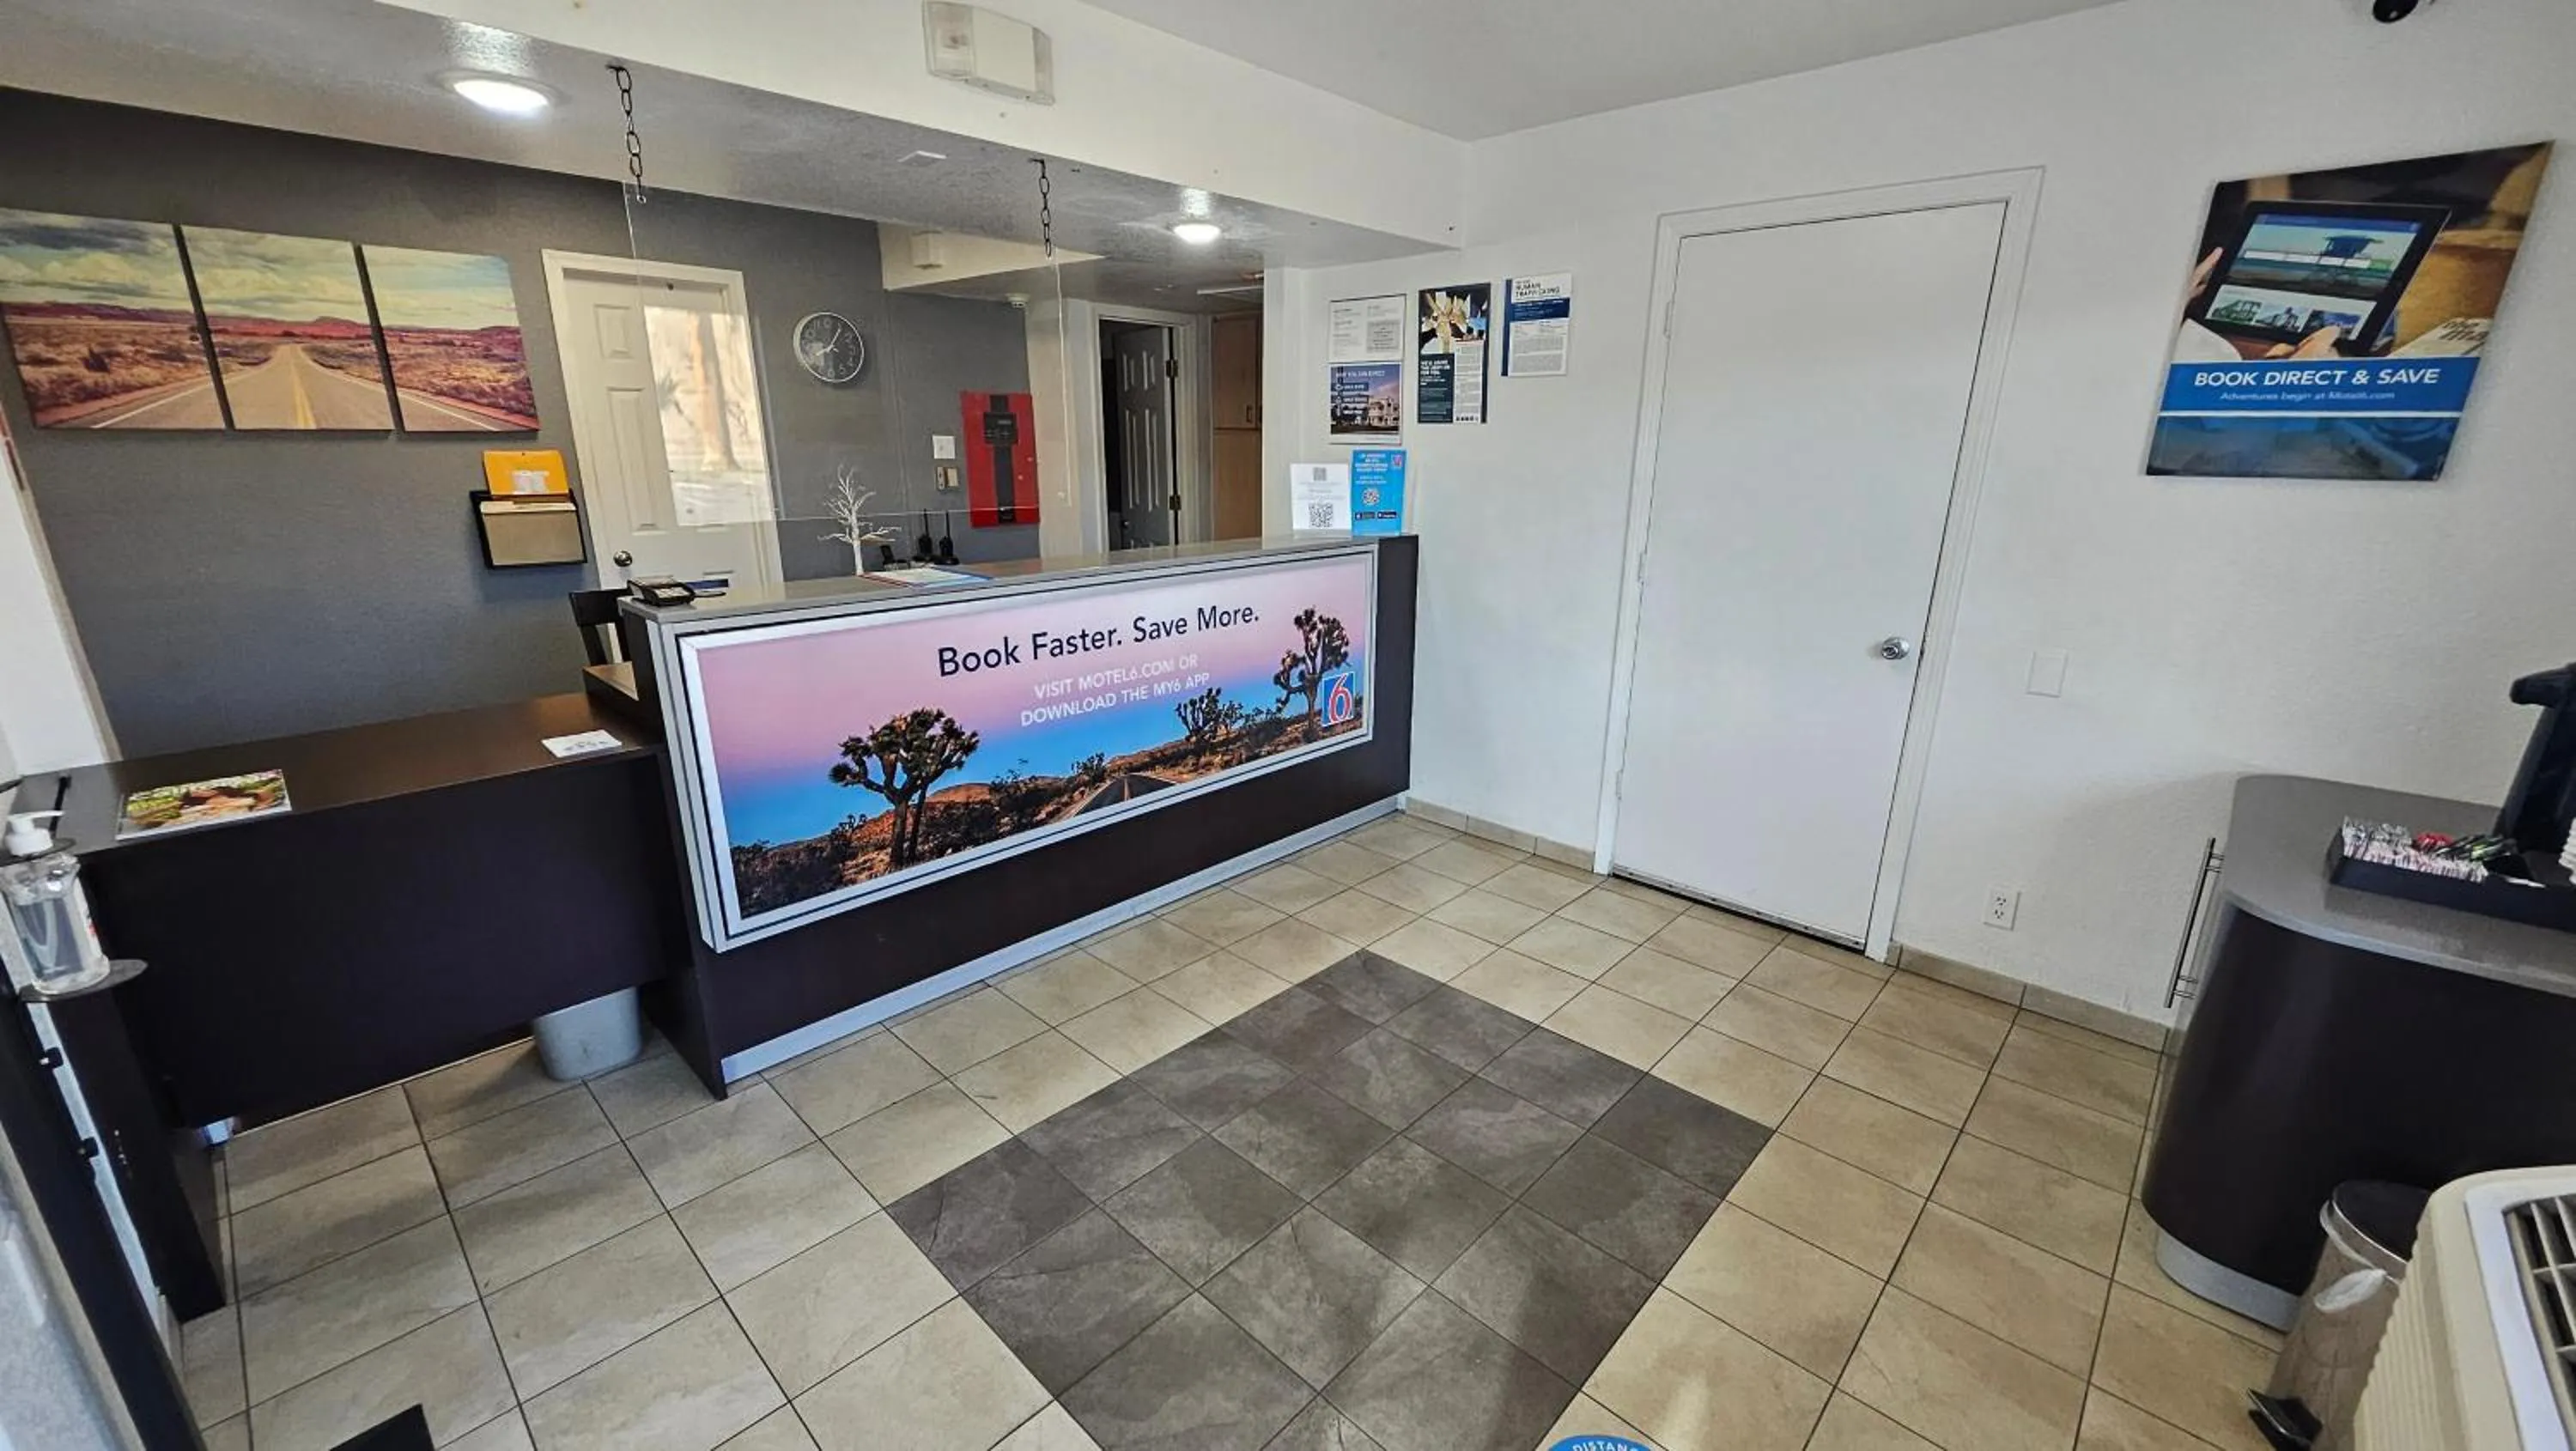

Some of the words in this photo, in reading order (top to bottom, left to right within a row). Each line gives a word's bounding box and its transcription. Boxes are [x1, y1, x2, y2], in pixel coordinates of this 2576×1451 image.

[2194, 372, 2259, 386] BOOK
[2263, 370, 2348, 386] DIRECT
[2351, 369, 2370, 385] &
[2376, 368, 2441, 385] SAVE
[938, 635, 1021, 677] Book
[1031, 628, 1122, 660] Faster.
[1133, 616, 1188, 643] Save
[1197, 604, 1260, 632] More.
[1021, 692, 1116, 726] DOWNLOAD
[1121, 685, 1149, 704] THE
[1153, 677, 1182, 697] MY6
[1185, 672, 1210, 689] APP
[1034, 677, 1073, 699] VISIT
[1078, 658, 1175, 691] MOTEL6.COM
[1179, 653, 1199, 670] OR
[1329, 673, 1352, 723] 6
